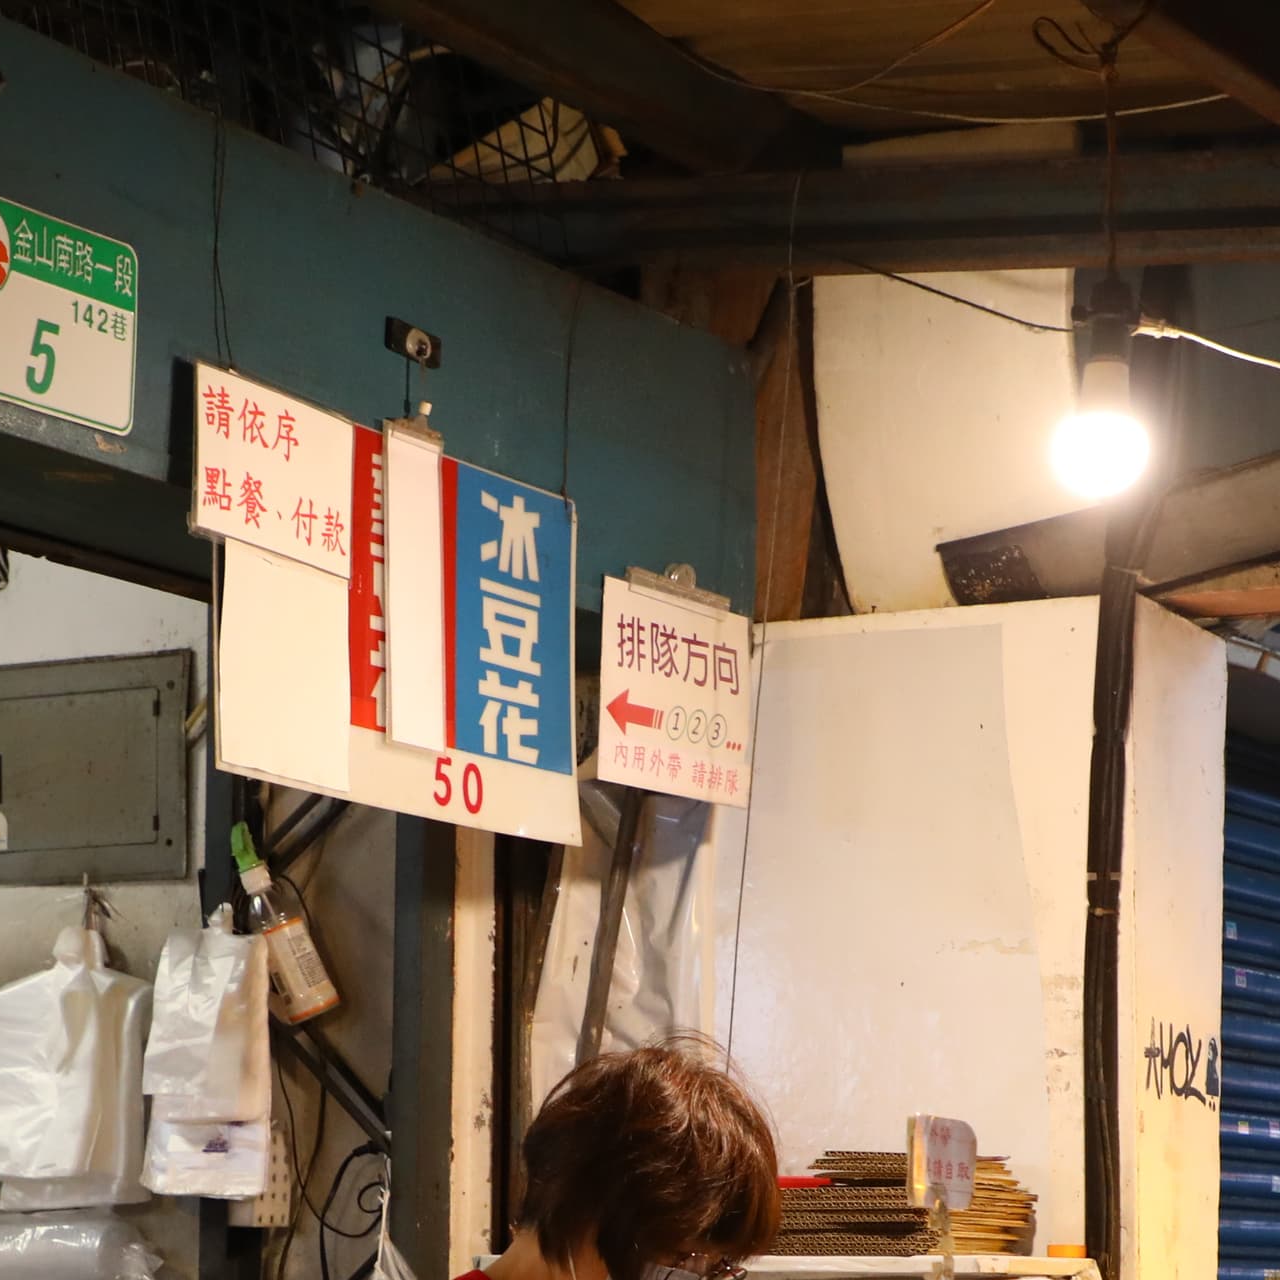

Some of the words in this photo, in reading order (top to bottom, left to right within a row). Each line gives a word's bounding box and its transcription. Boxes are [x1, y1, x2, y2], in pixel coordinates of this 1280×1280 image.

[13, 218, 134, 298] 金山南路一段
[25, 318, 61, 395] 5
[71, 300, 128, 342] 142巷
[202, 385, 300, 463] 請依序
[202, 466, 348, 556] 點餐、付款
[478, 490, 542, 766] 冰豆花
[616, 613, 740, 696] 排隊方向
[432, 756, 484, 815] 50
[614, 741, 682, 783] 內用外帶
[691, 759, 739, 797] 請排隊
